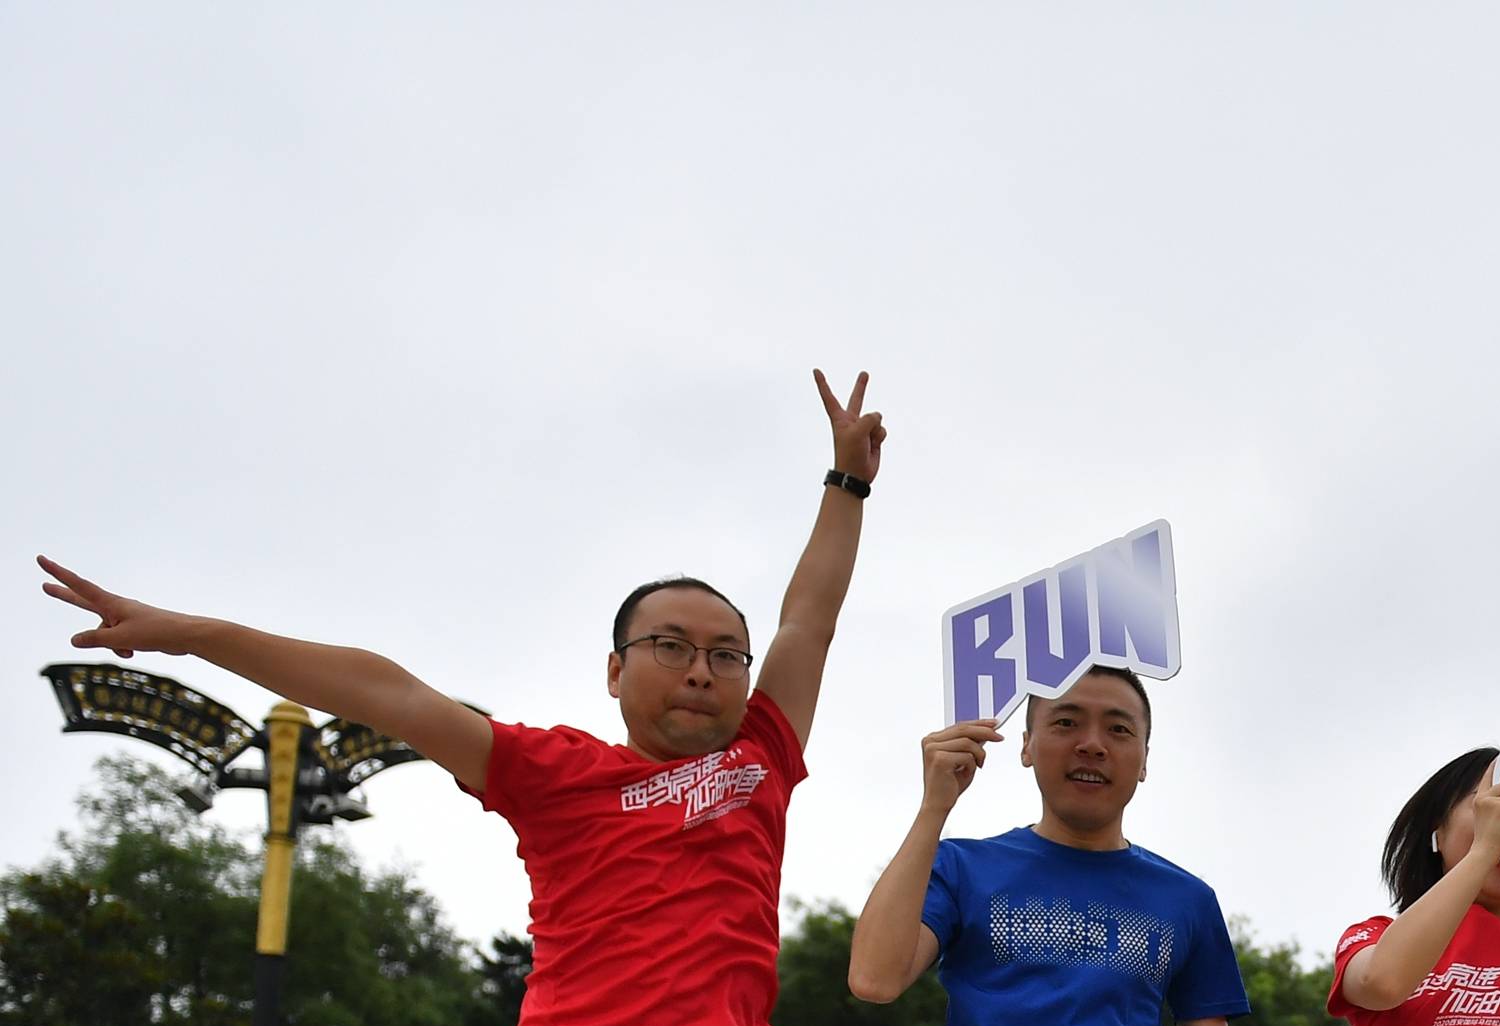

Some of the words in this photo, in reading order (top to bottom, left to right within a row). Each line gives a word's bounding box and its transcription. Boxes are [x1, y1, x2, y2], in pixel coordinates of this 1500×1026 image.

[951, 529, 1168, 721] RUN
[685, 763, 769, 819] 加油中国
